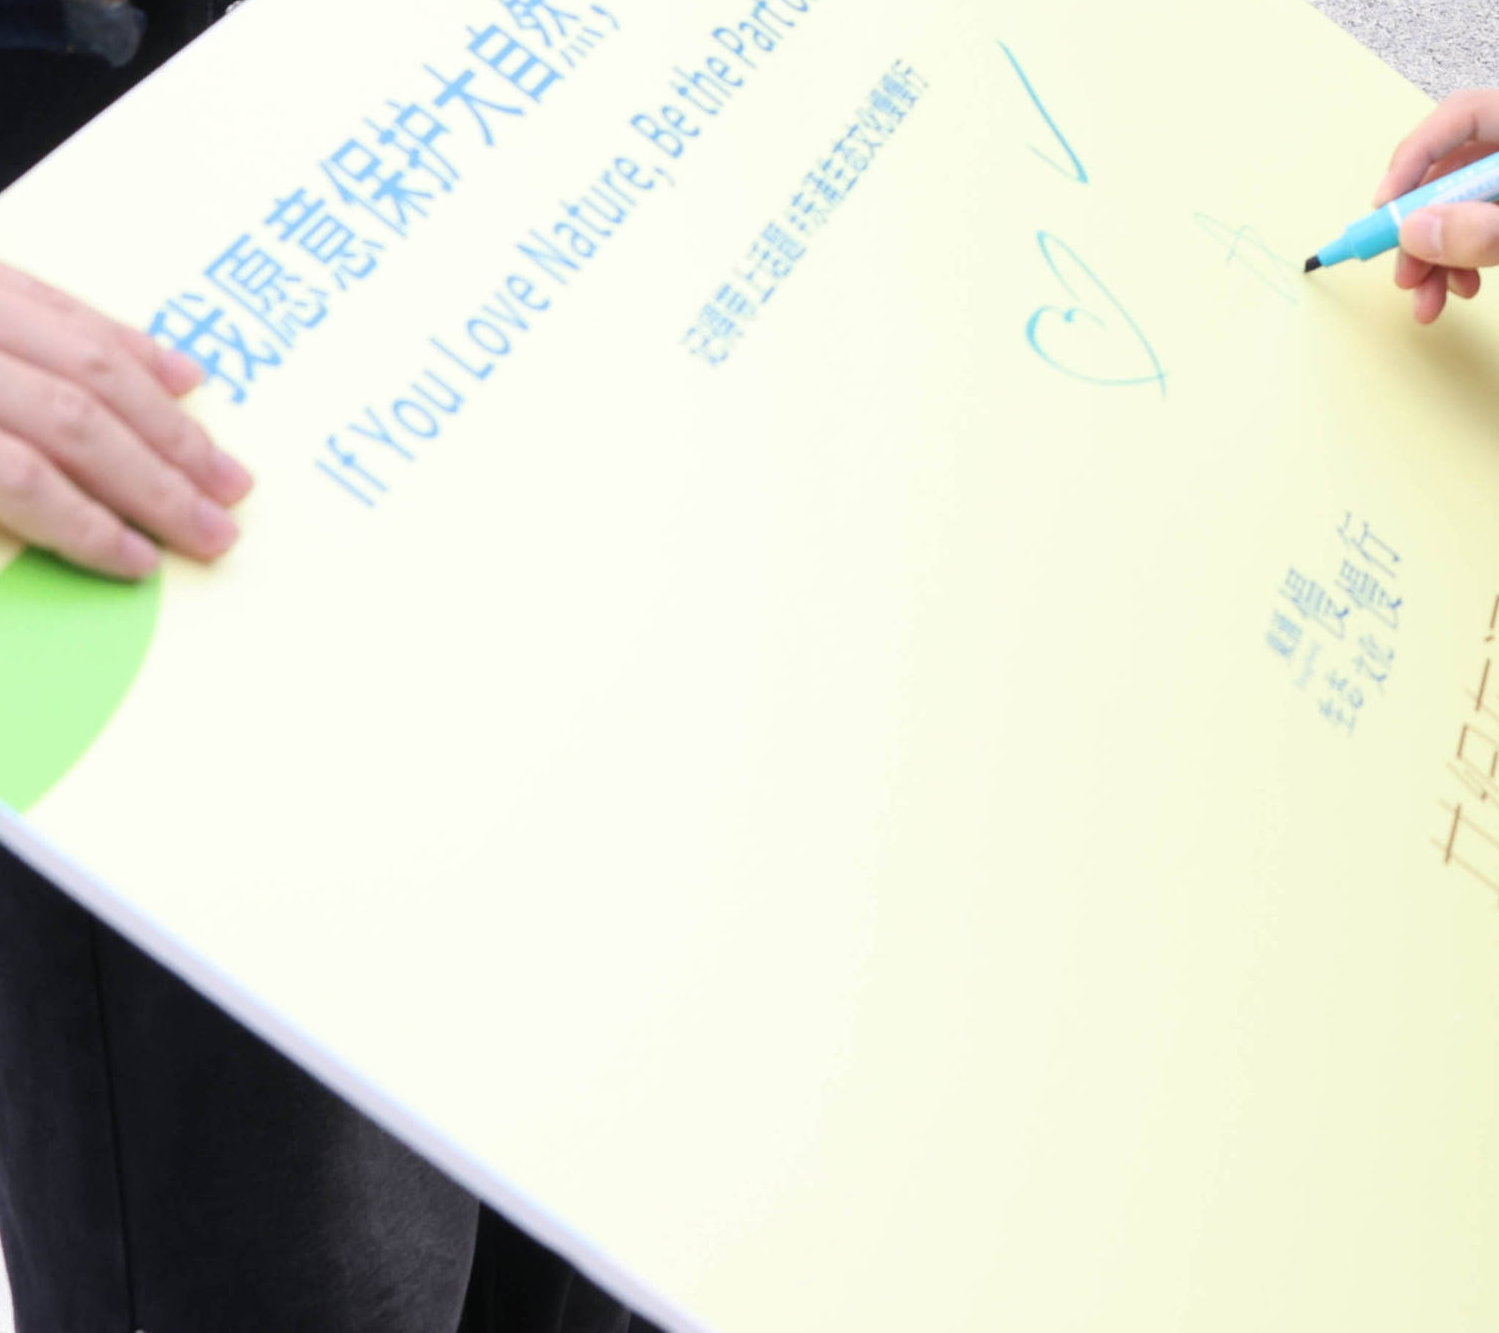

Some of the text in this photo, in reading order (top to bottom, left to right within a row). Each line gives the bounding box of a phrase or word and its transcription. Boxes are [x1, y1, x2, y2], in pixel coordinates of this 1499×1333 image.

[630, 104, 702, 159] Be
[669, 63, 745, 117] the
[515, 155, 678, 288] Nature,
[429, 271, 552, 382] Love
[348, 369, 465, 463] You
[316, 434, 389, 509] If
